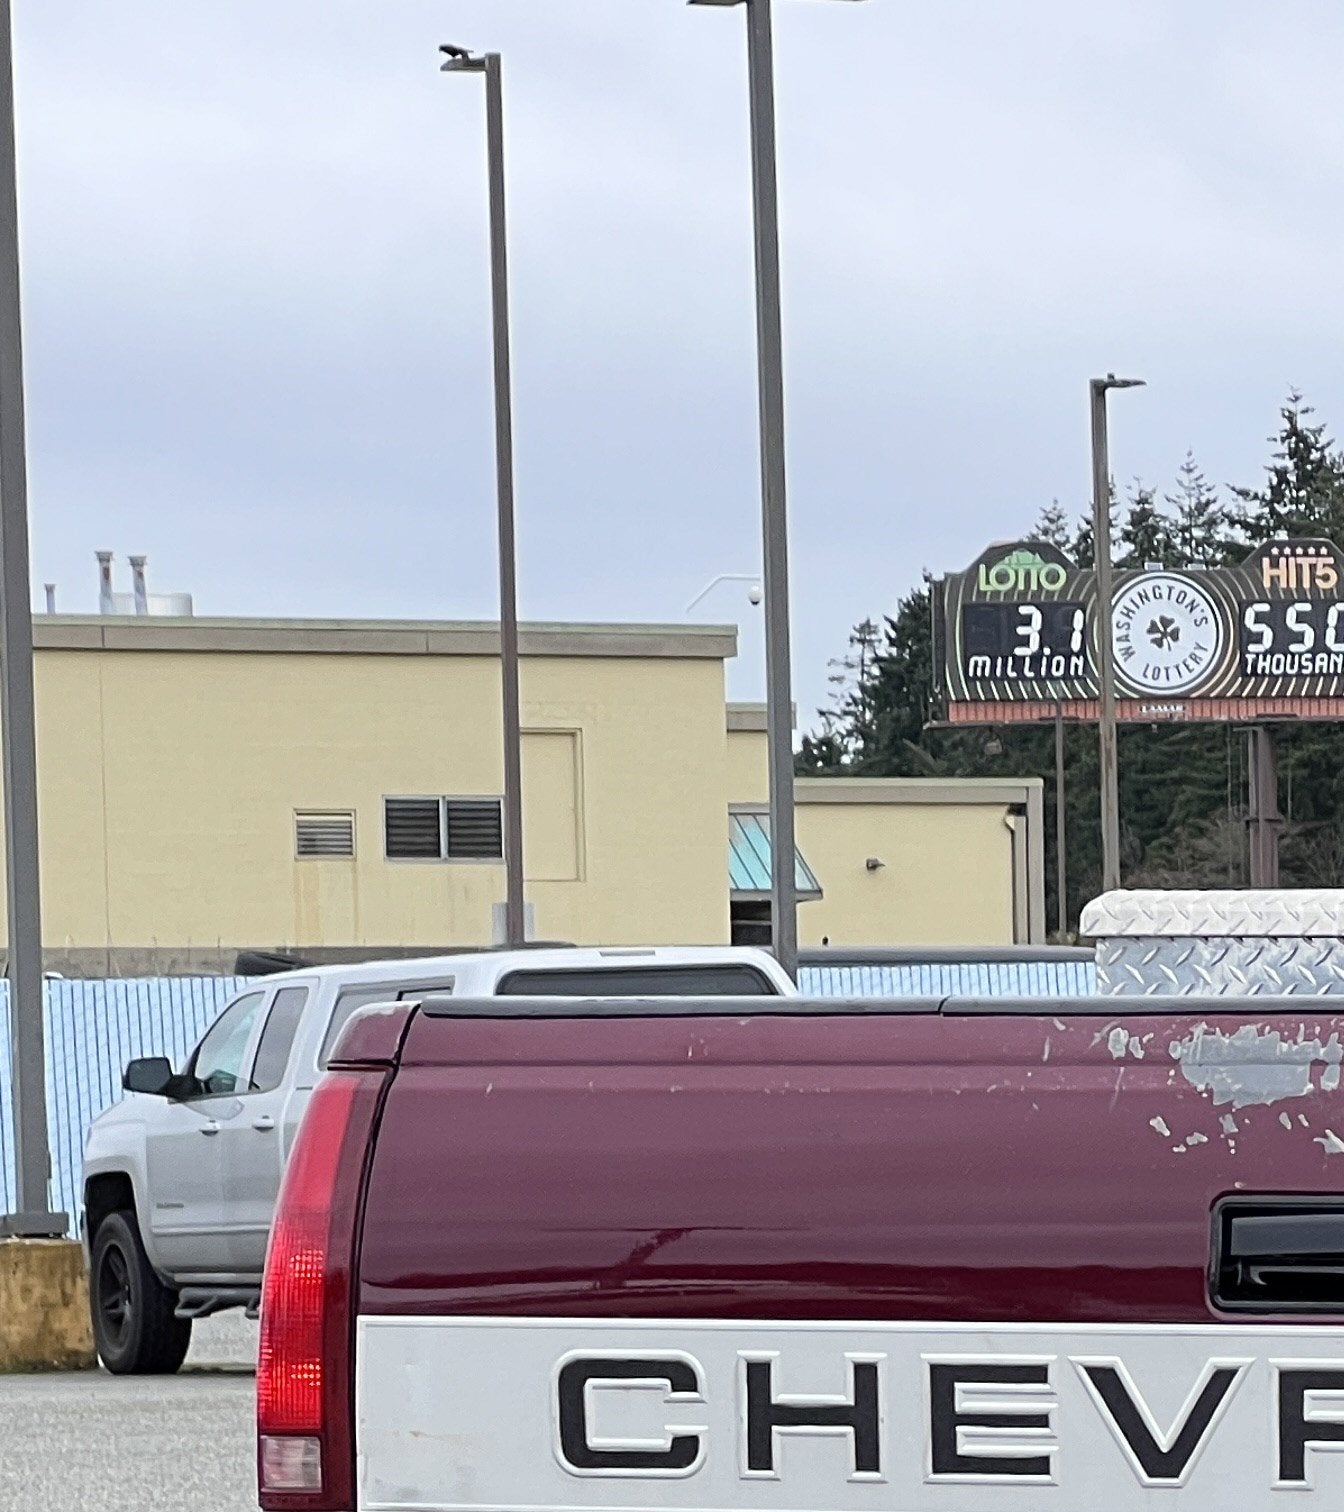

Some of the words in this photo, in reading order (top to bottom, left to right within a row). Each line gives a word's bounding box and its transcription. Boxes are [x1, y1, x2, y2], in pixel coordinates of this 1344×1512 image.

[979, 563, 1067, 591] LOTTO
[1013, 605, 1084, 656] 3.1
[1116, 585, 1208, 662] WASHINGTON'S
[1142, 641, 1208, 681] LOTTERY
